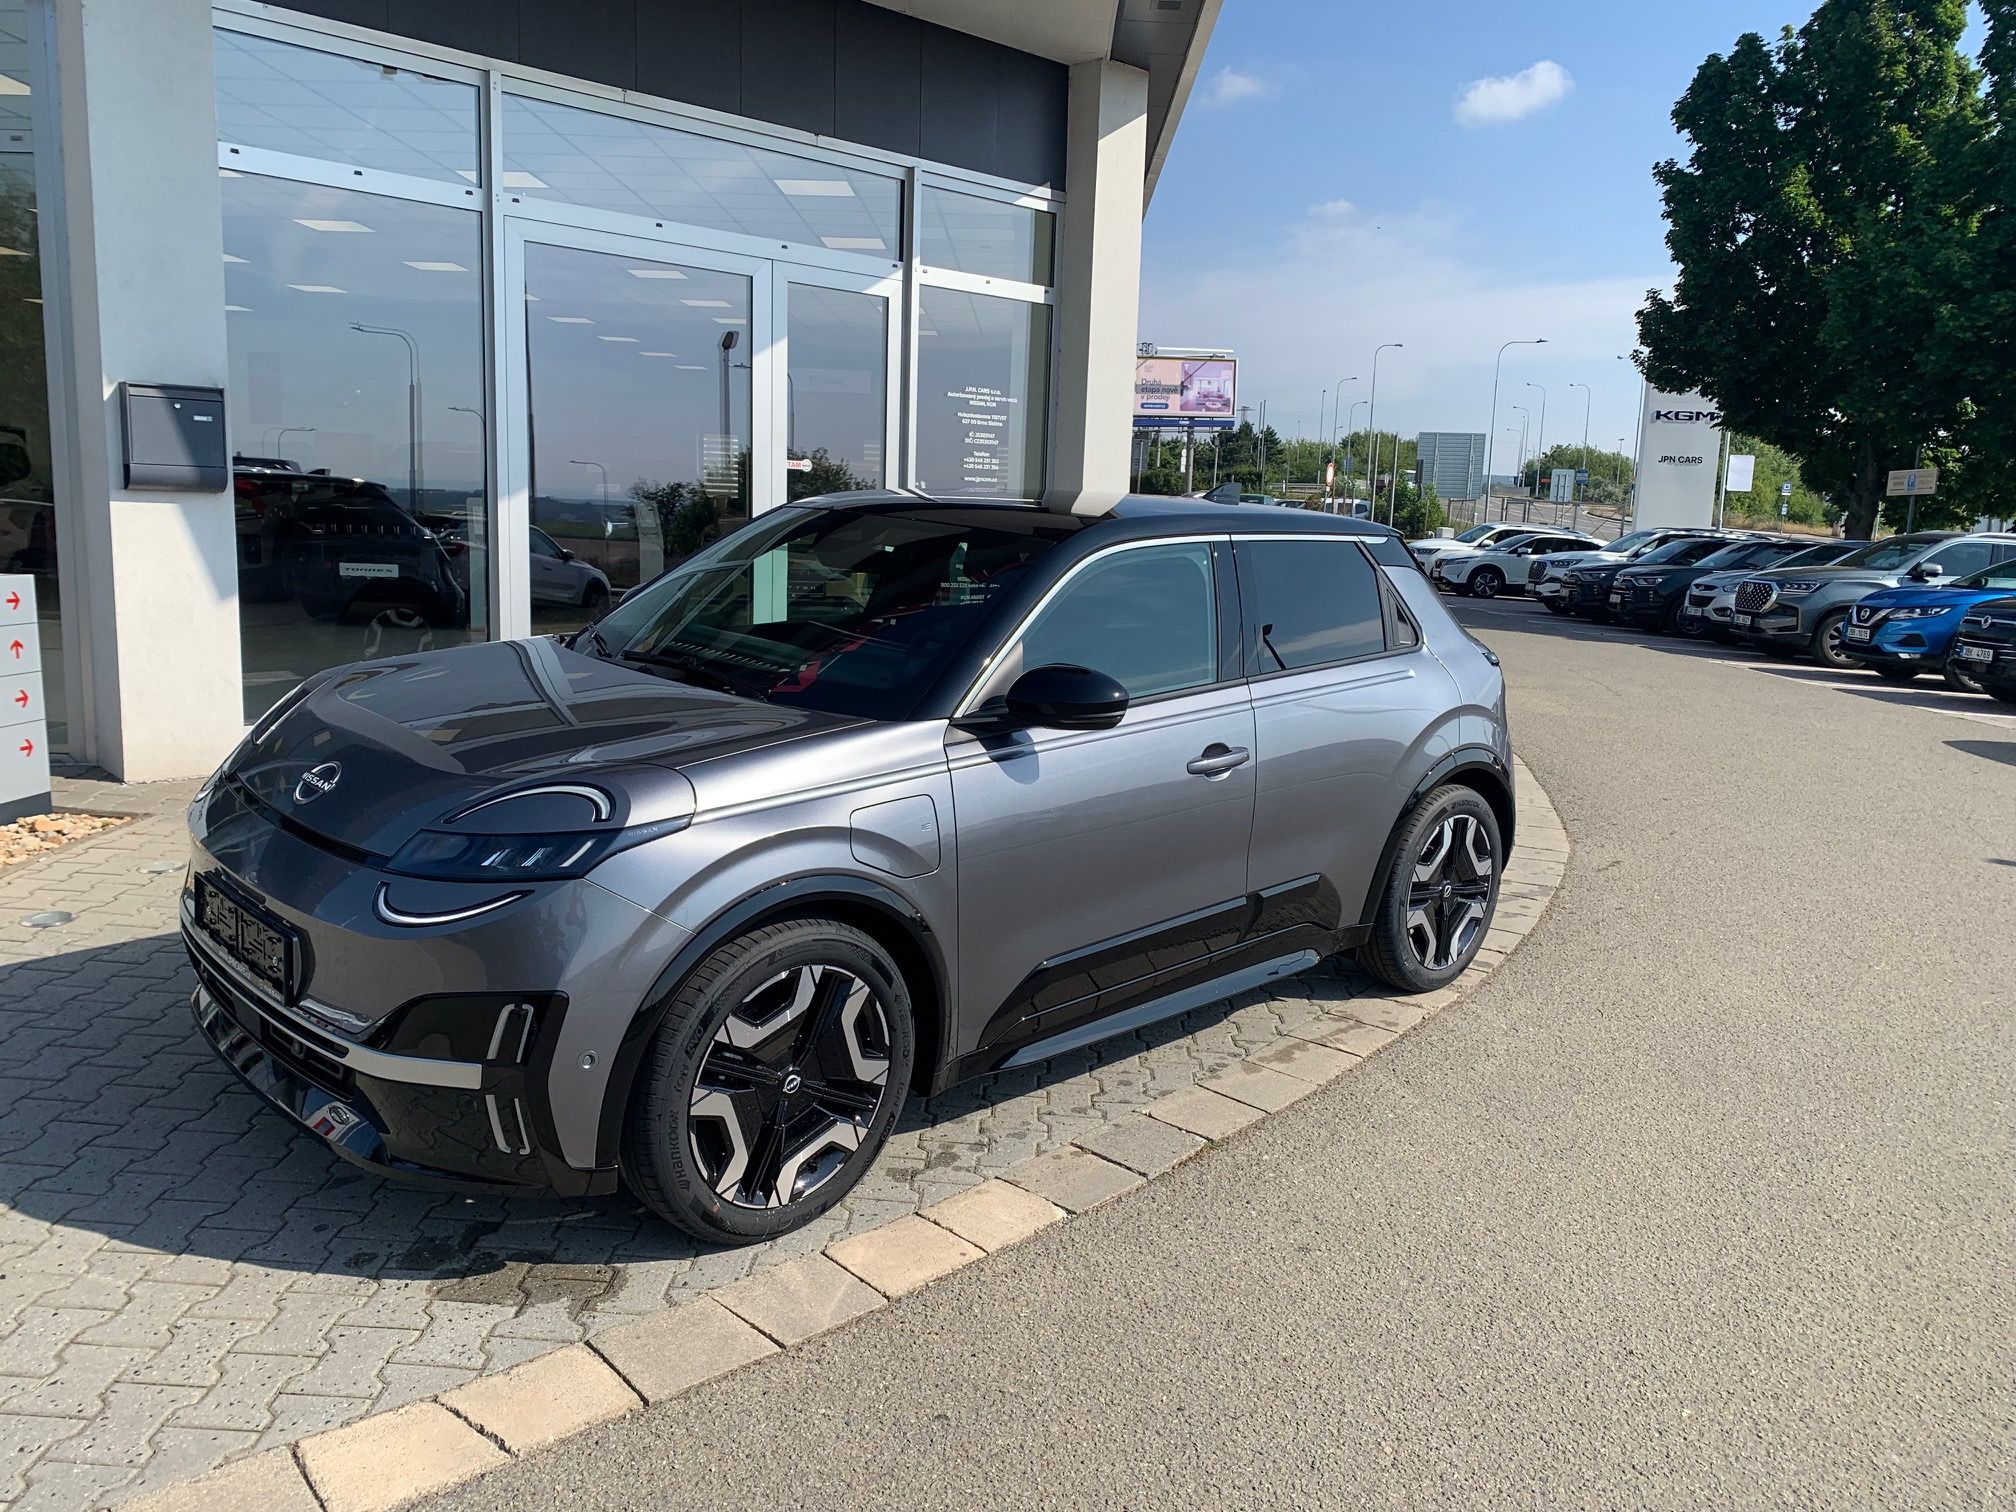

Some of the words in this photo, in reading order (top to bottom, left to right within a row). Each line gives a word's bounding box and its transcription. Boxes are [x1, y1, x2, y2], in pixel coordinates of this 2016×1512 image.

[1141, 386, 1160, 394] etapa
[1655, 410, 1720, 422] KGM
[1657, 455, 1676, 464] JPN
[1678, 456, 1703, 464] CARS
[302, 771, 332, 791] NISSAN
